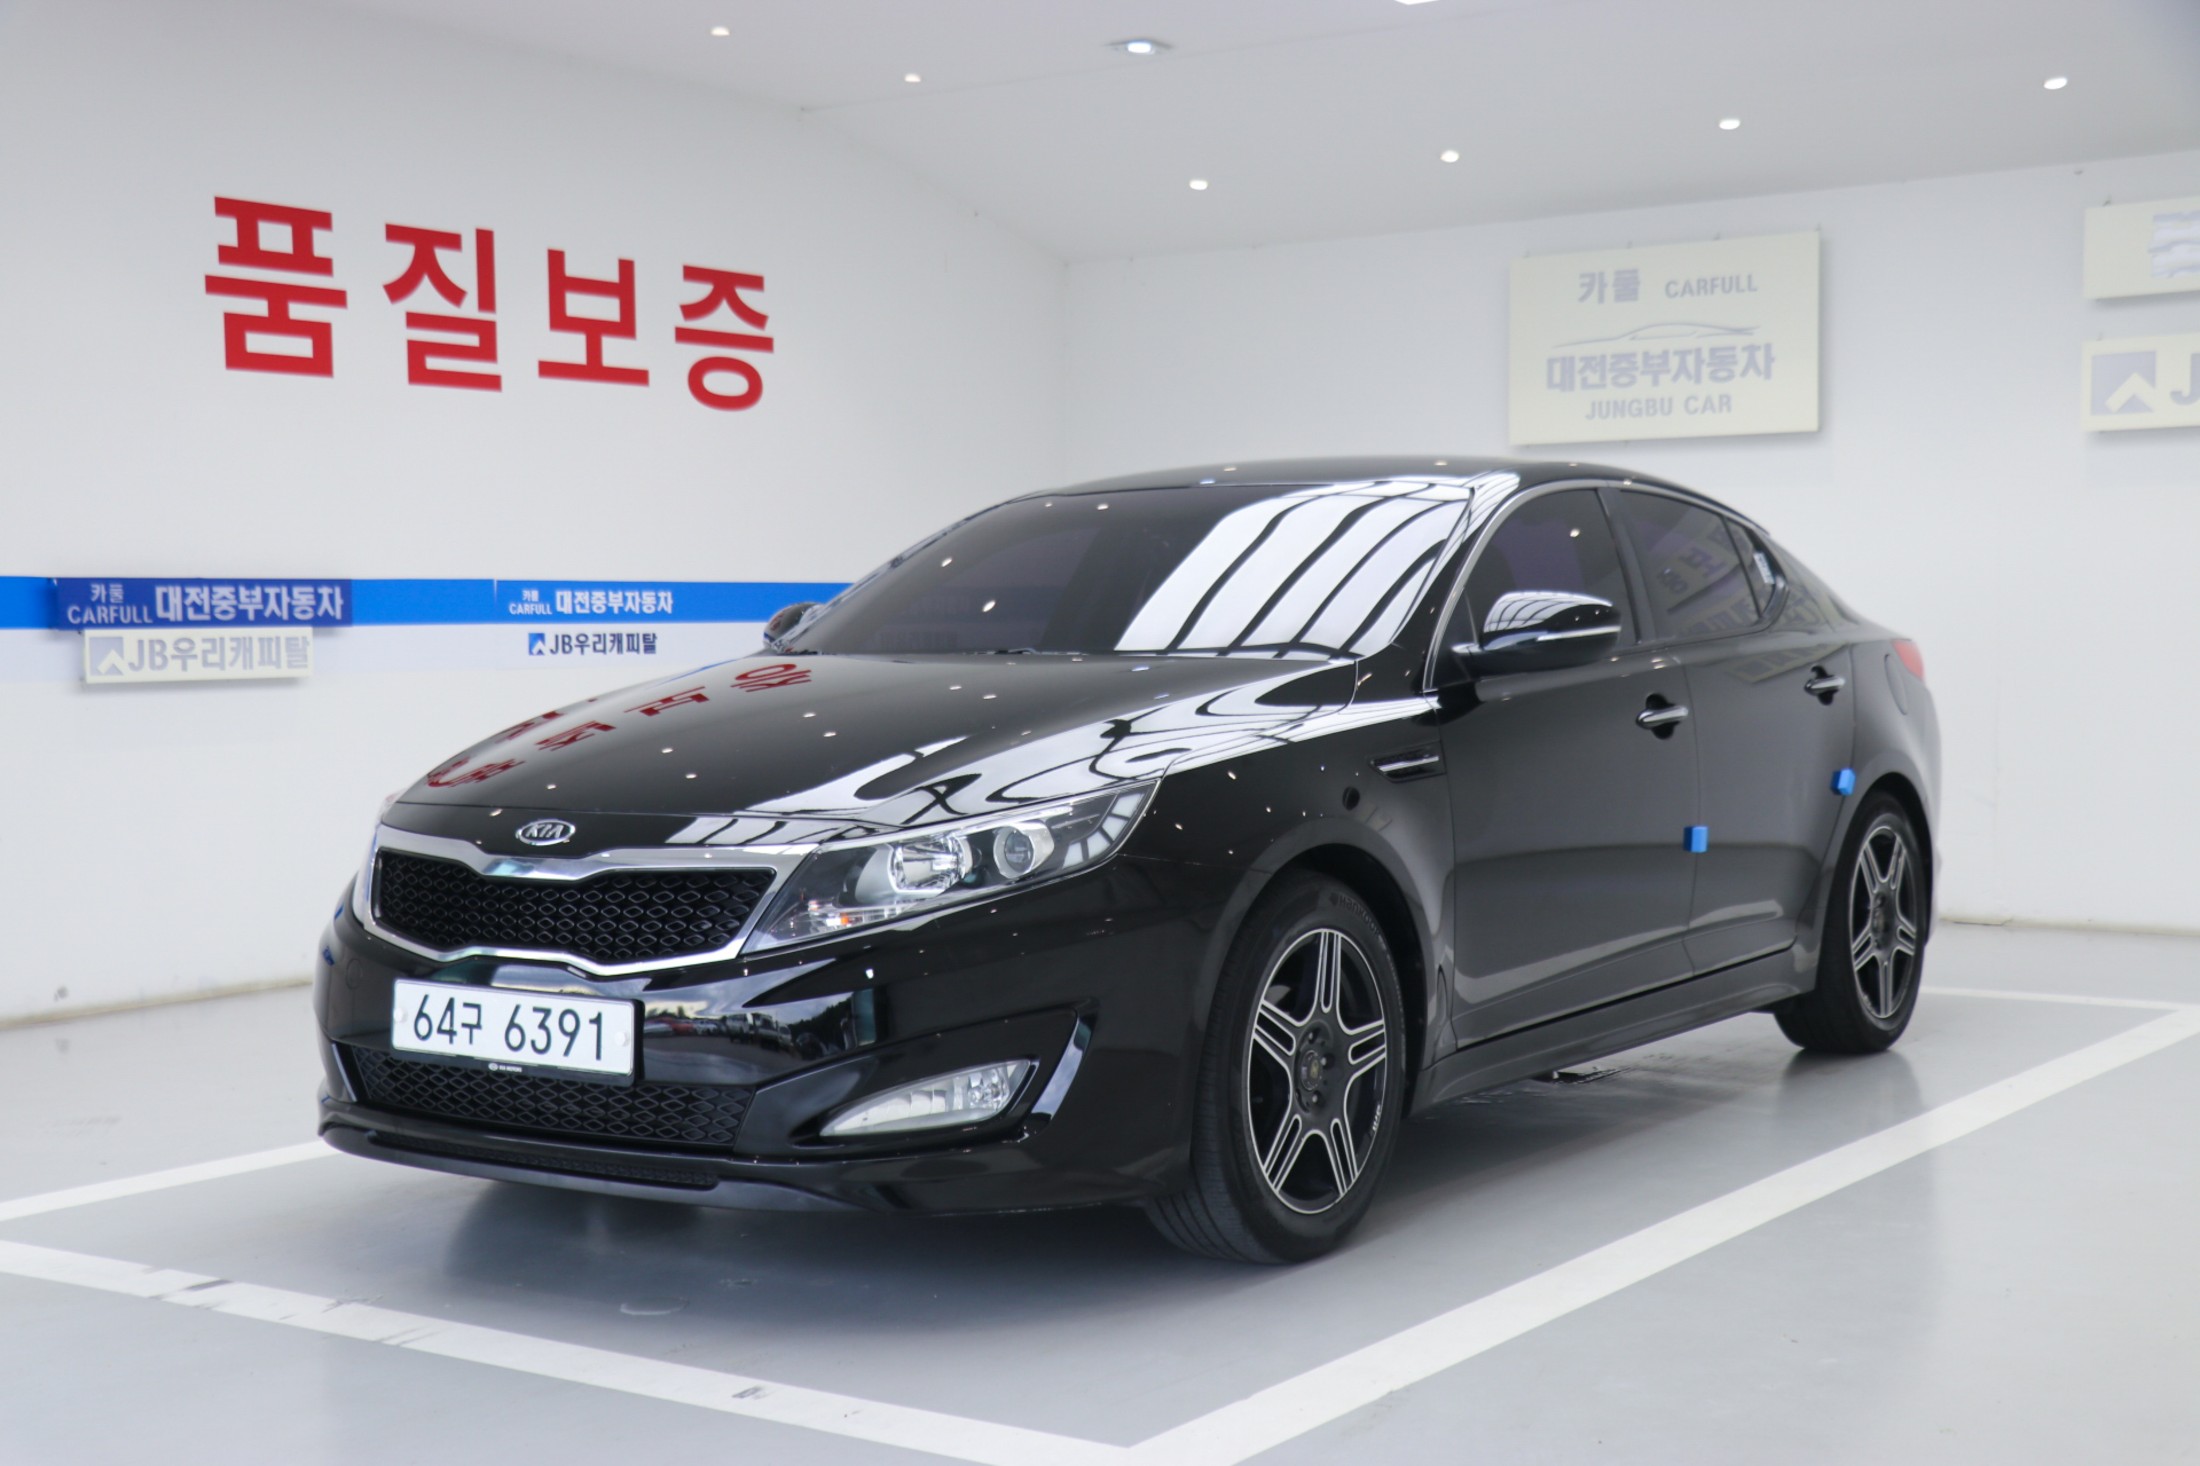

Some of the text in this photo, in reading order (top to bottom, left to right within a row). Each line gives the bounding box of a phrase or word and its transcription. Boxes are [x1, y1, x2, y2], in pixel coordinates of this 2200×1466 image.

[1664, 274, 1759, 299] CARFULL
[204, 196, 774, 411] 품질보증
[1546, 343, 1776, 392] 대전중부자동차
[1585, 394, 1733, 420] JUNGBU CAR
[67, 605, 153, 624] CARFULL
[154, 584, 344, 621] 대전중부자동차
[508, 602, 553, 615] CARFULL
[555, 589, 674, 615] 대전중부자동차
[127, 635, 311, 672] JB우리캐피탈
[549, 632, 658, 656] JB우리캐피탈
[413, 993, 603, 1061] 64구 6391
